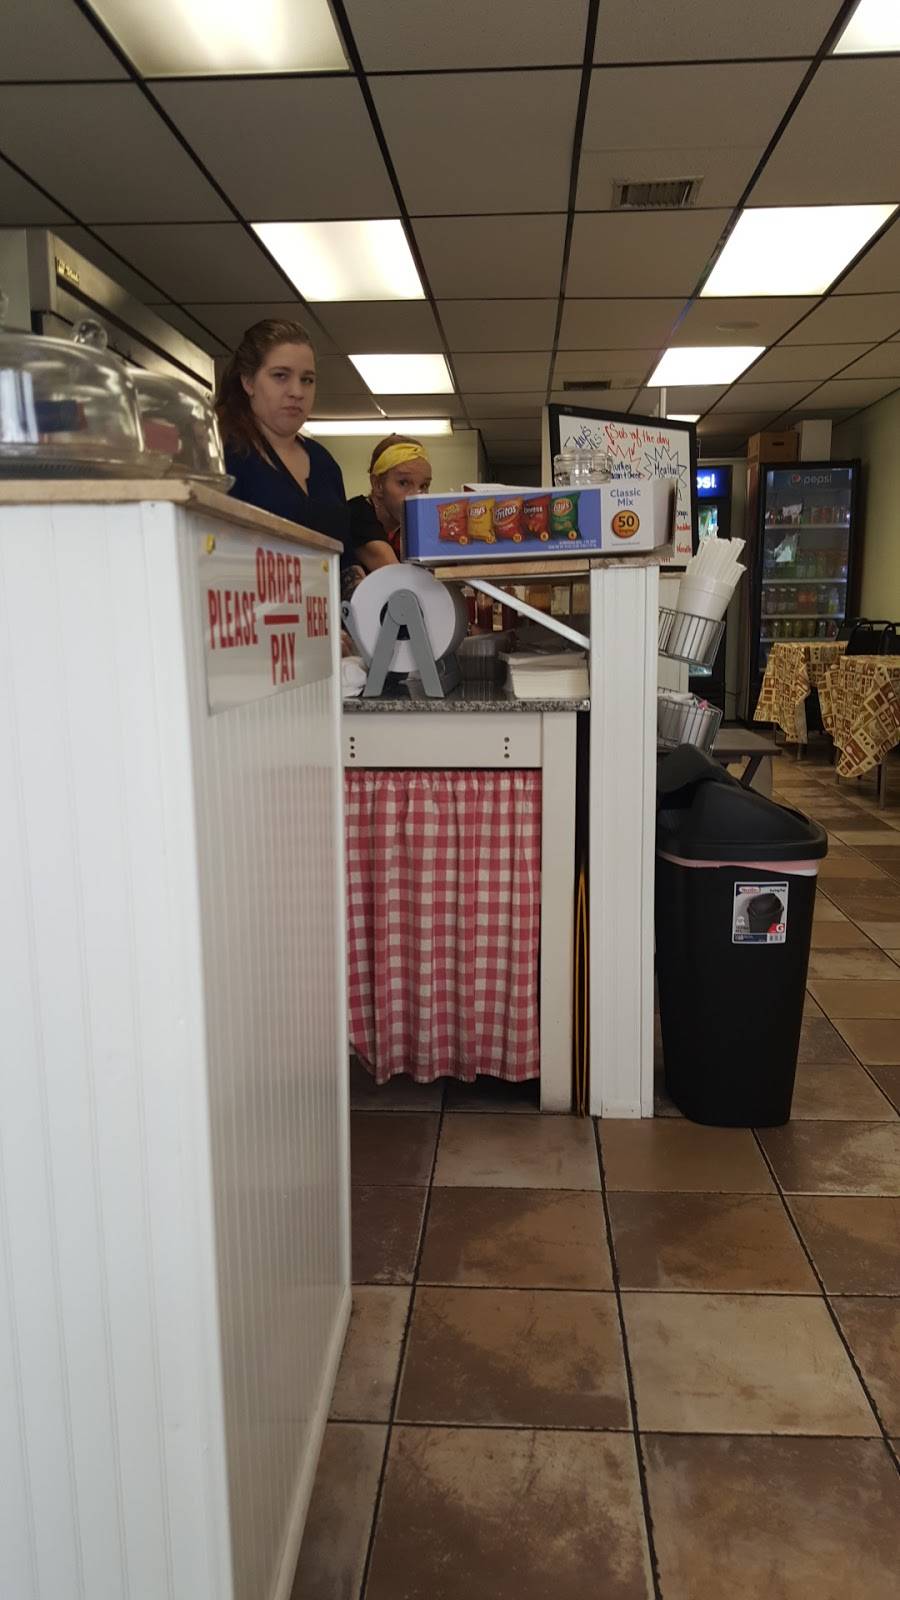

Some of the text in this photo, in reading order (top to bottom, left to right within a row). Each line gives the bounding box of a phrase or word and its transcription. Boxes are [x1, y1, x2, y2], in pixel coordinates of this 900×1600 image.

[610, 423, 628, 439] Sub
[643, 429, 655, 443] the
[656, 432, 671, 447] day
[803, 474, 832, 487] pepsi
[609, 487, 641, 498] Classic
[617, 498, 634, 507] Mix
[618, 515, 635, 528] 50
[207, 547, 329, 650] PLEASE ORDER HERE
[270, 632, 296, 686] PAY
